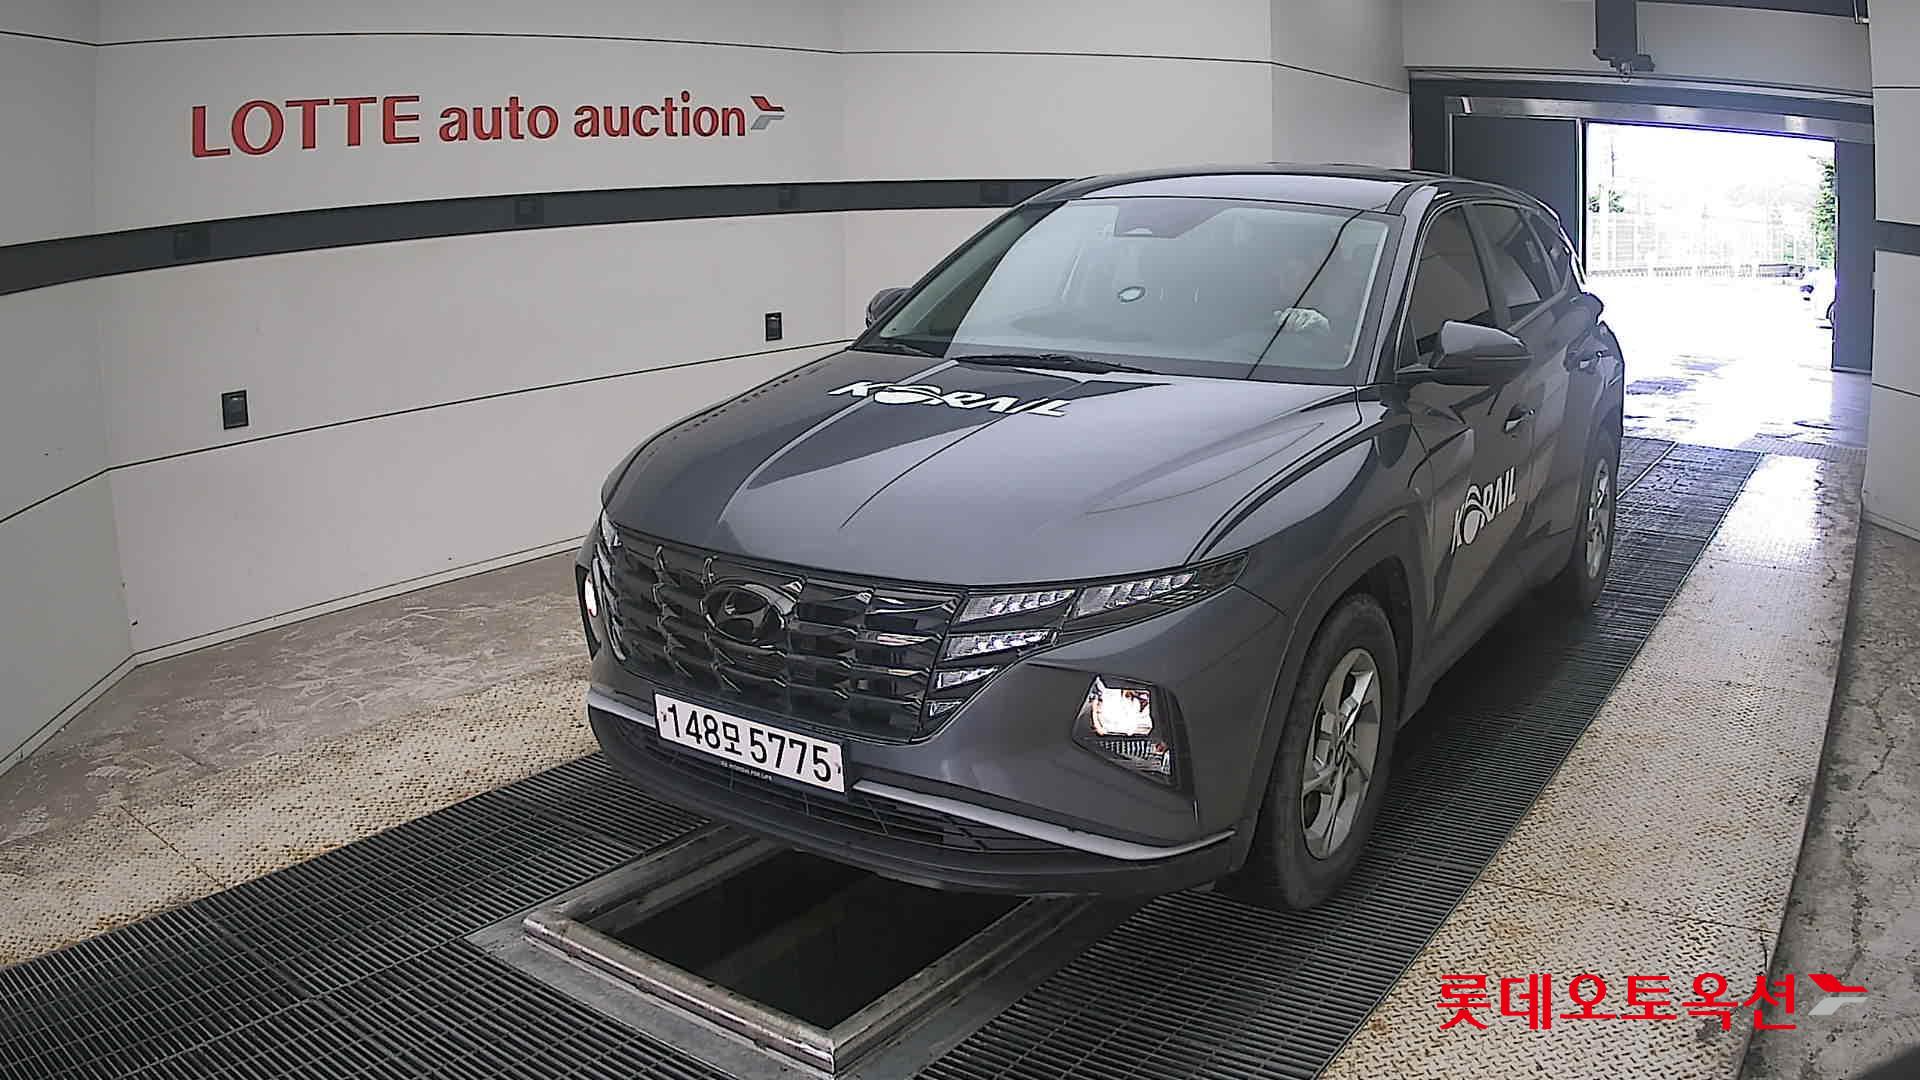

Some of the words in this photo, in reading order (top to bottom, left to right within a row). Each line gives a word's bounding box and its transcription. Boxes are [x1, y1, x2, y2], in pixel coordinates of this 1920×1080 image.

[192, 96, 420, 158] LOTTE
[438, 96, 559, 142] auto
[573, 90, 746, 139] auction
[827, 380, 1071, 418] KORAIL
[1450, 466, 1517, 555] KORAIL
[749, 727, 832, 783] 5775
